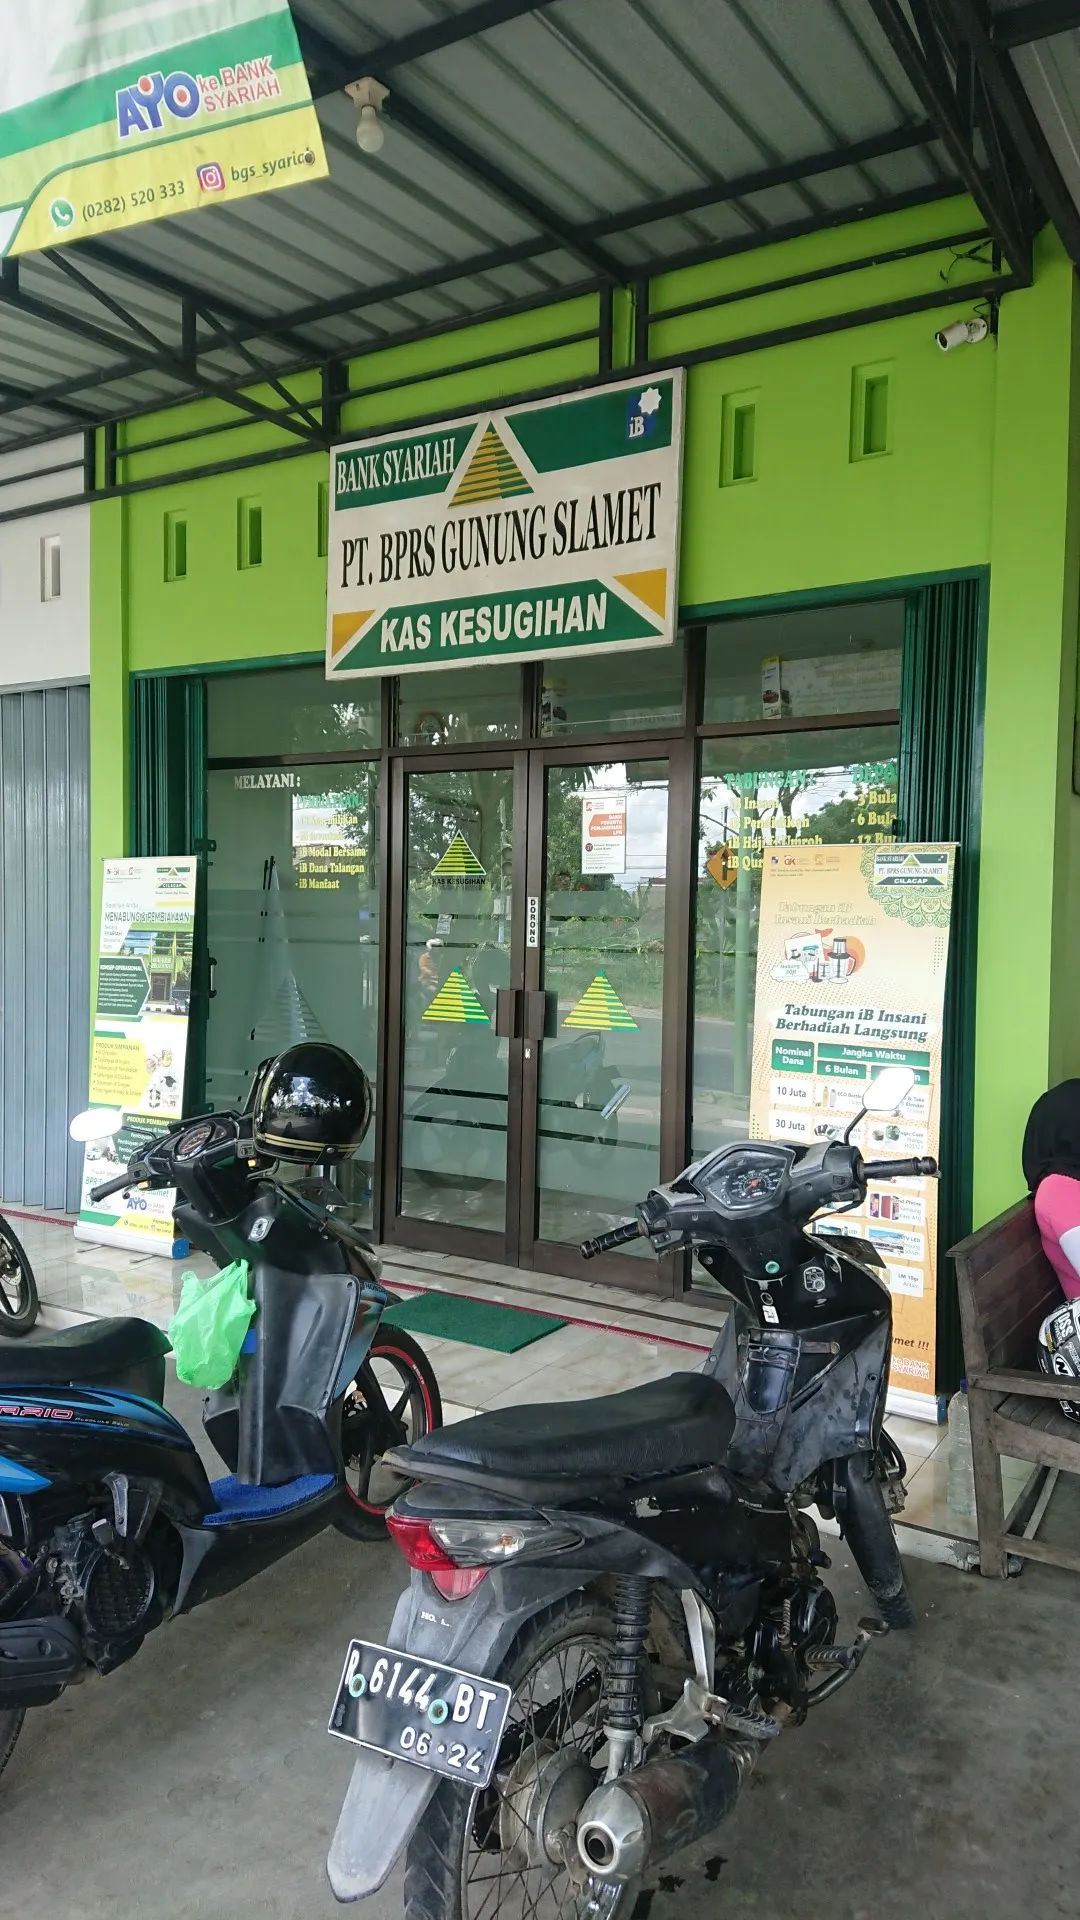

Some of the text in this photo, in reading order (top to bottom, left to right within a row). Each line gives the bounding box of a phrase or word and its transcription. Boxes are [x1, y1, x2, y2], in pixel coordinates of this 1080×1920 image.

[116, 56, 273, 138] AYO ke BANK
[204, 79, 280, 113] SYARIAH
[82, 180, 185, 222] (0282) 520 333
[628, 416, 645, 438] iB
[337, 438, 456, 494] BANK SYARIAH
[341, 482, 661, 588] PT. BPRS GUNUNG SLAMET
[380, 592, 607, 653] KAS KESUGIHAN
[852, 762, 897, 784] DEPO
[857, 790, 897, 807] 3 Bula
[857, 811, 897, 826] 6 Bula
[309, 847, 331, 857] Modal
[333, 848, 366, 857] Bersama
[728, 836, 740, 848] iB
[743, 836, 766, 853] Haji
[299, 863, 364, 875] iB Dana Talangan
[727, 855, 764, 870] iB Qur
[887, 867, 899, 875] BPRS
[900, 867, 922, 875] GUNUNG
[923, 867, 943, 875] SLAMET
[299, 879, 340, 889] iB Manfaat
[104, 911, 139, 922] MENABUNG
[147, 911, 190, 922] PEMBIAYAAN
[784, 1003, 927, 1024] Tabungan iB Insani
[776, 1018, 928, 1043] Berhadiah Langsung
[775, 1046, 906, 1061] Nominal Jangka Waktu
[782, 1056, 804, 1066] Dana
[825, 1065, 859, 1076] 6 Bulan
[776, 1086, 807, 1098] 10 Juta
[775, 1119, 806, 1131] 30 Juta
[127, 1198, 147, 1210] AYO
[918, 1341, 929, 1350] !!!
[893, 1364, 929, 1378] SYARIAH
[904, 1358, 928, 1370] BANK
[345, 1650, 496, 1730] R 6144 BT
